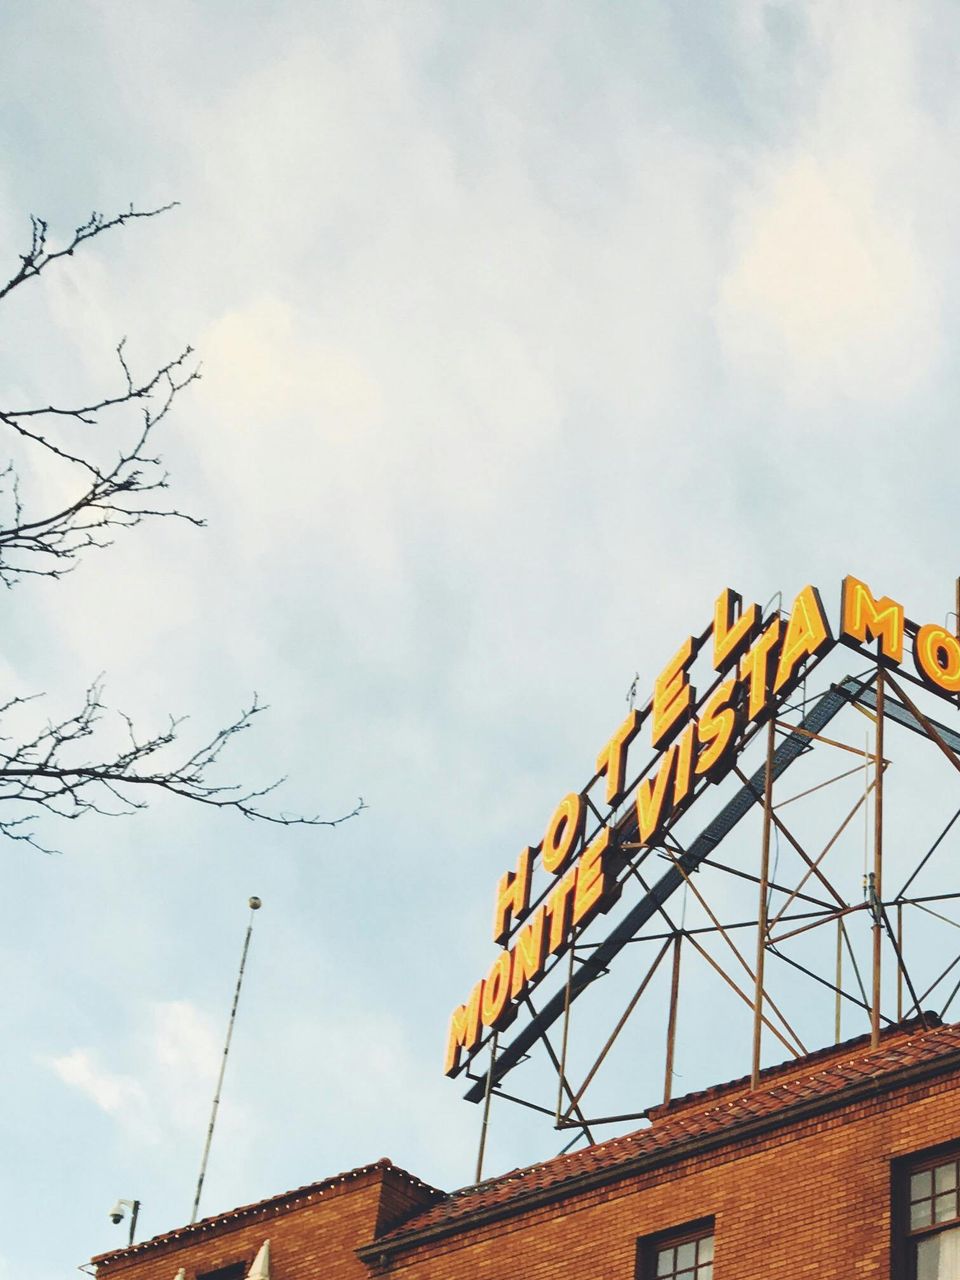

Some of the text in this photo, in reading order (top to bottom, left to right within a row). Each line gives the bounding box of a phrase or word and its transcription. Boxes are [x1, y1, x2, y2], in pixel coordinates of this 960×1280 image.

[444, 584, 836, 1080] MONTE VISTA
[493, 586, 764, 944] HOTEL
